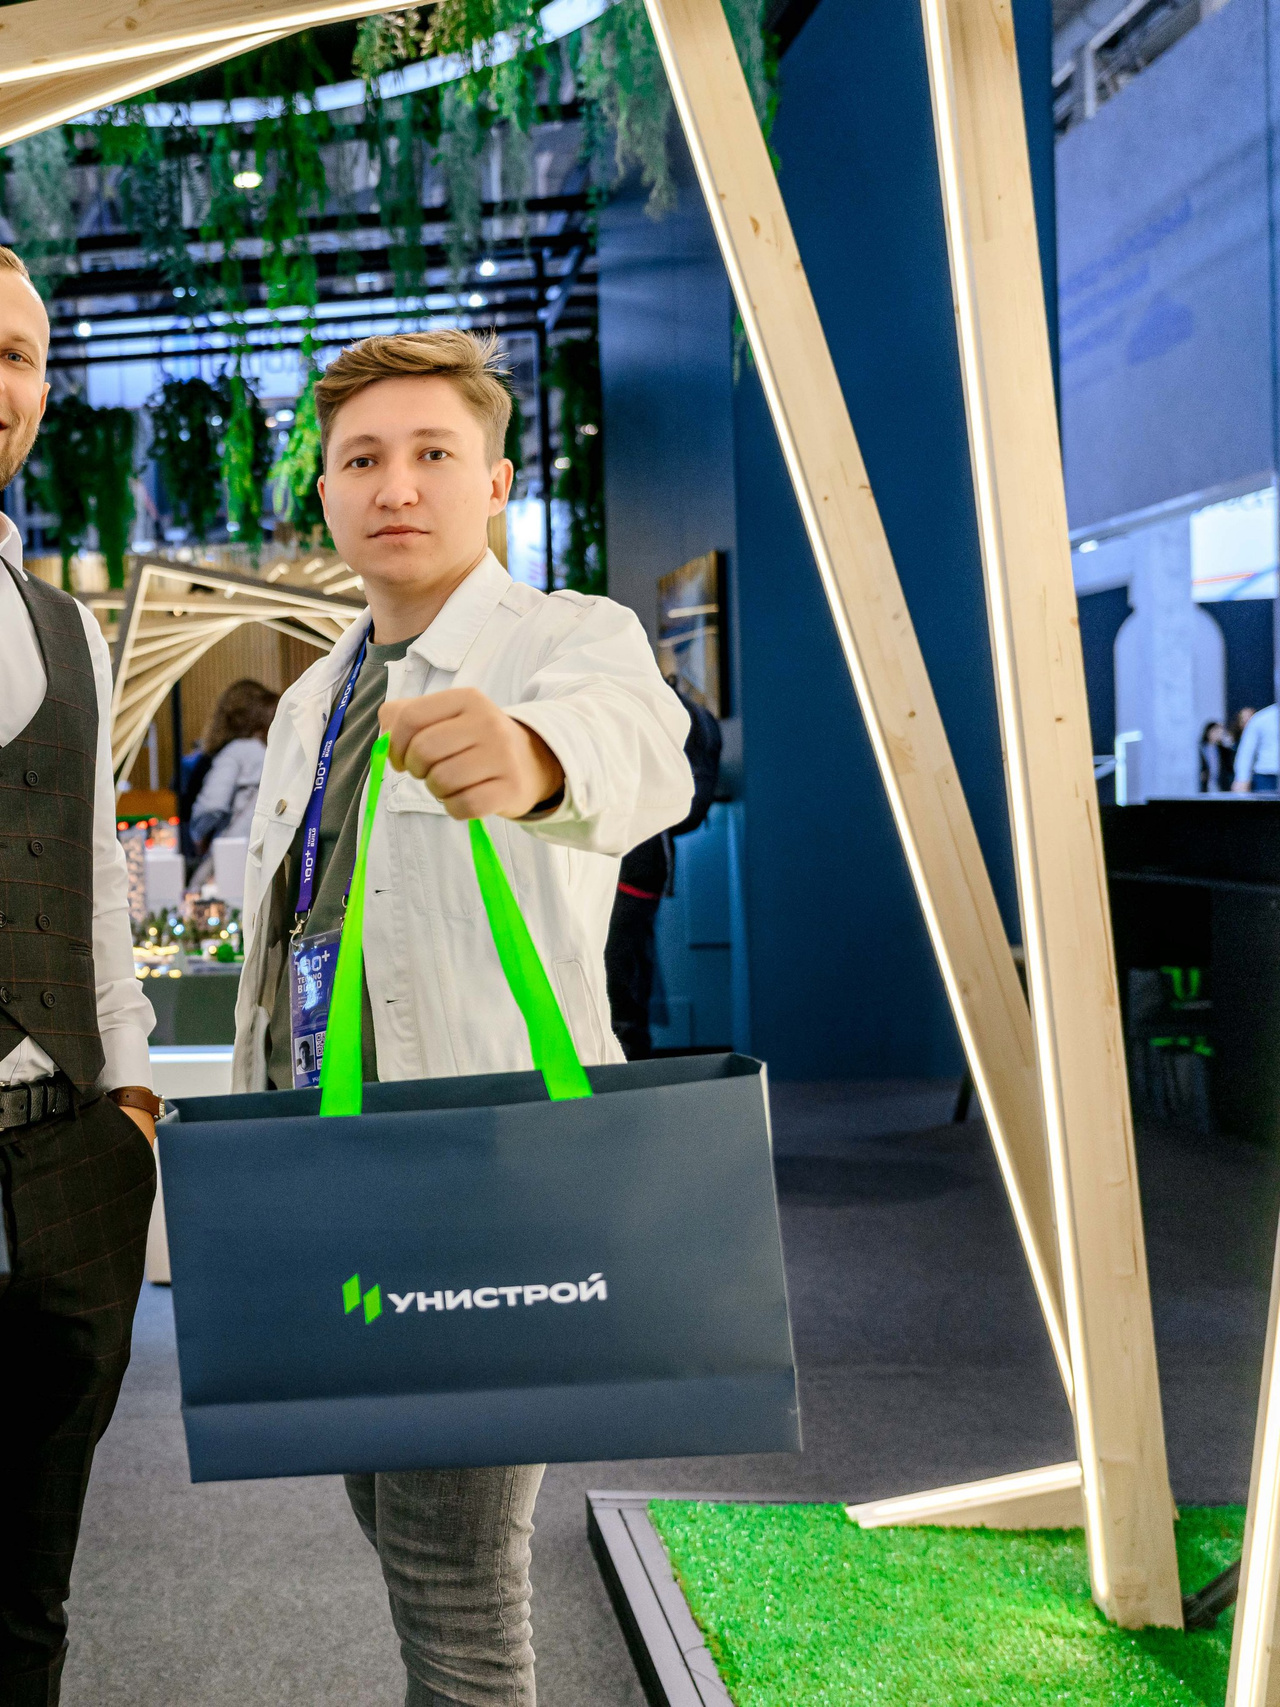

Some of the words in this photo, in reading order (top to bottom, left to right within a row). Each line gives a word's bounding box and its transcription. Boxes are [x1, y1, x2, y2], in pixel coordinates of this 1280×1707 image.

[338, 682, 352, 710] 100+
[313, 760, 326, 792] 100+
[304, 850, 314, 884] 100+
[297, 972, 322, 985] TENO
[297, 980, 322, 994] BUD
[387, 1272, 607, 1313] УНИСТРОЙ
